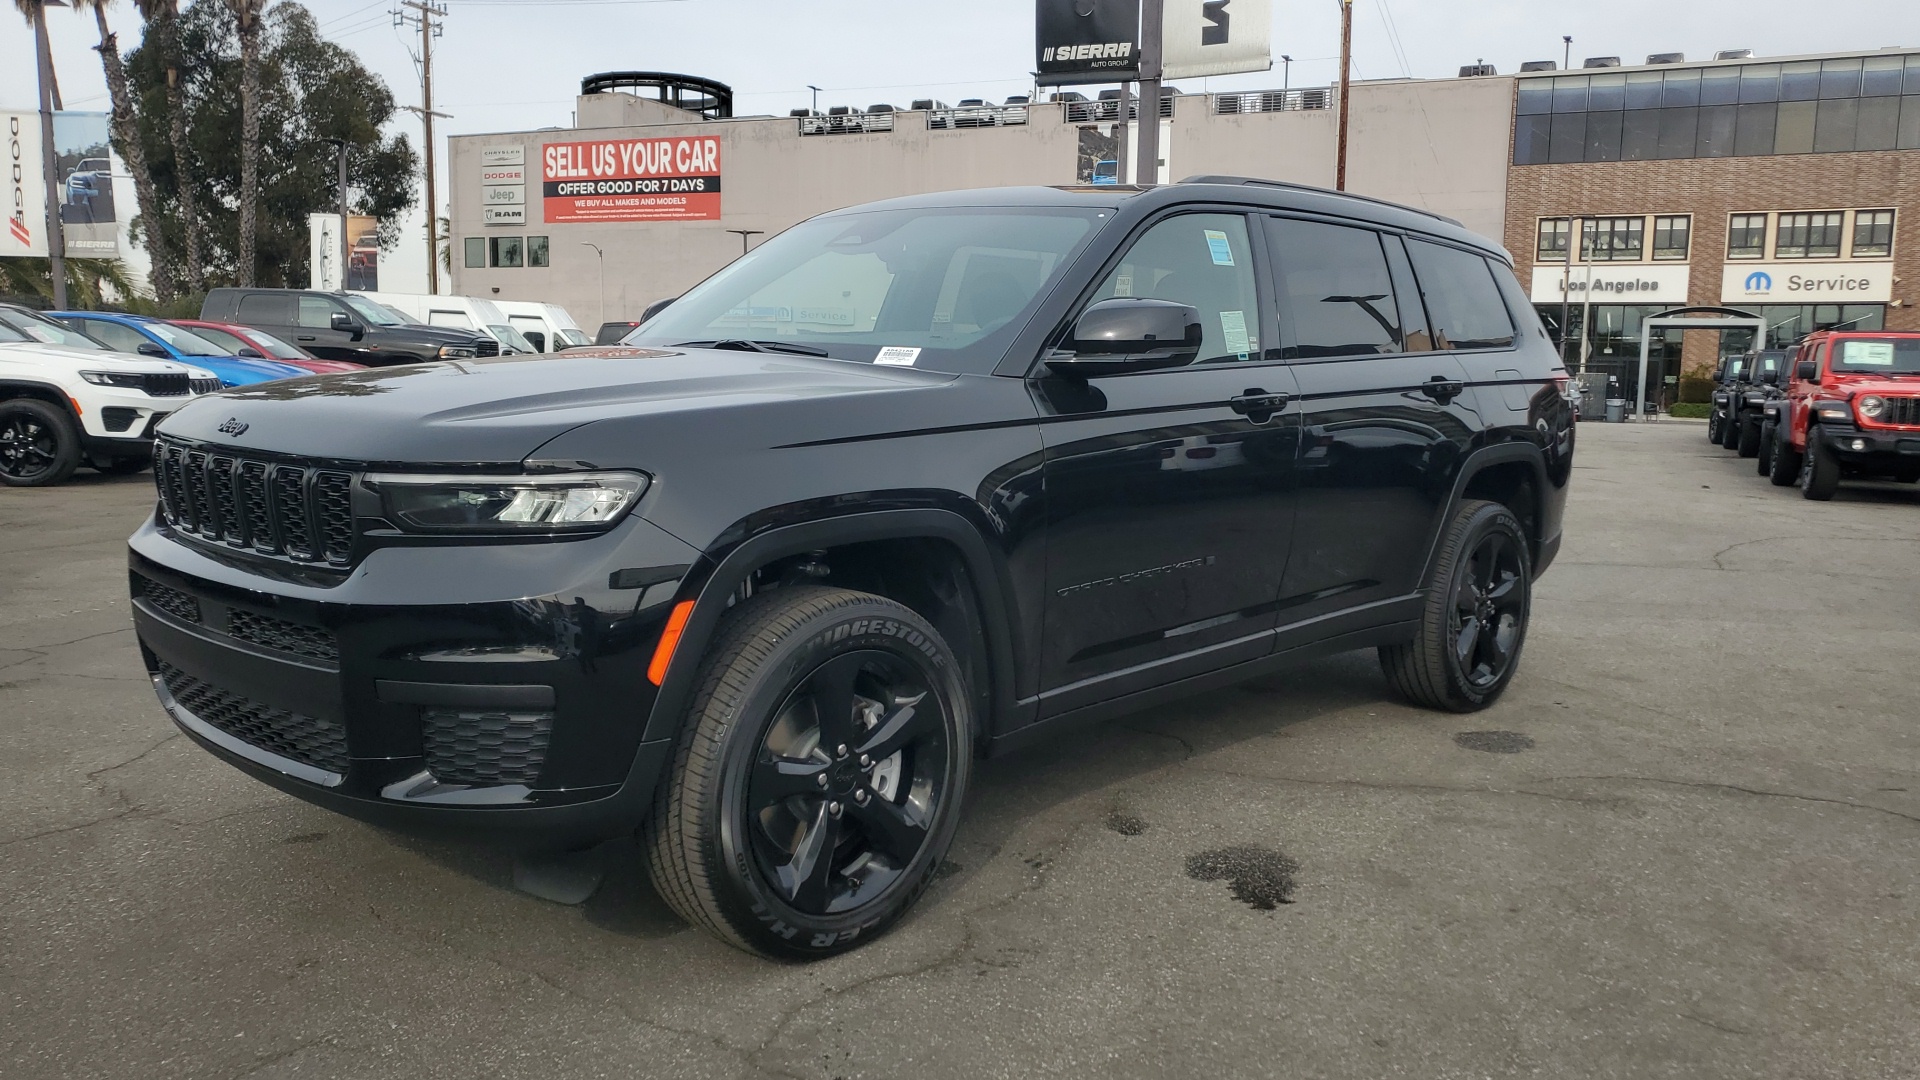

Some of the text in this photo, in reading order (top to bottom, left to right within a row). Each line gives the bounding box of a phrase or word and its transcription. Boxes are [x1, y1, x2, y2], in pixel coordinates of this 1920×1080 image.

[1056, 42, 1132, 61] SIERRA
[545, 139, 717, 178] SELL US YOUR CAR
[10, 116, 25, 229] DODGE
[557, 178, 704, 195] OFFER GOOD FOR 7 DAYS
[489, 188, 515, 202] Jeep
[586, 199, 601, 207] BUY
[615, 198, 640, 206] MAKES
[656, 197, 687, 205] MODELS
[75, 240, 115, 248] SIERRA
[1559, 278, 1659, 294] Los Angeles
[1787, 275, 1870, 291] Service
[800, 310, 847, 321] Service
[217, 416, 250, 438] Jeep
